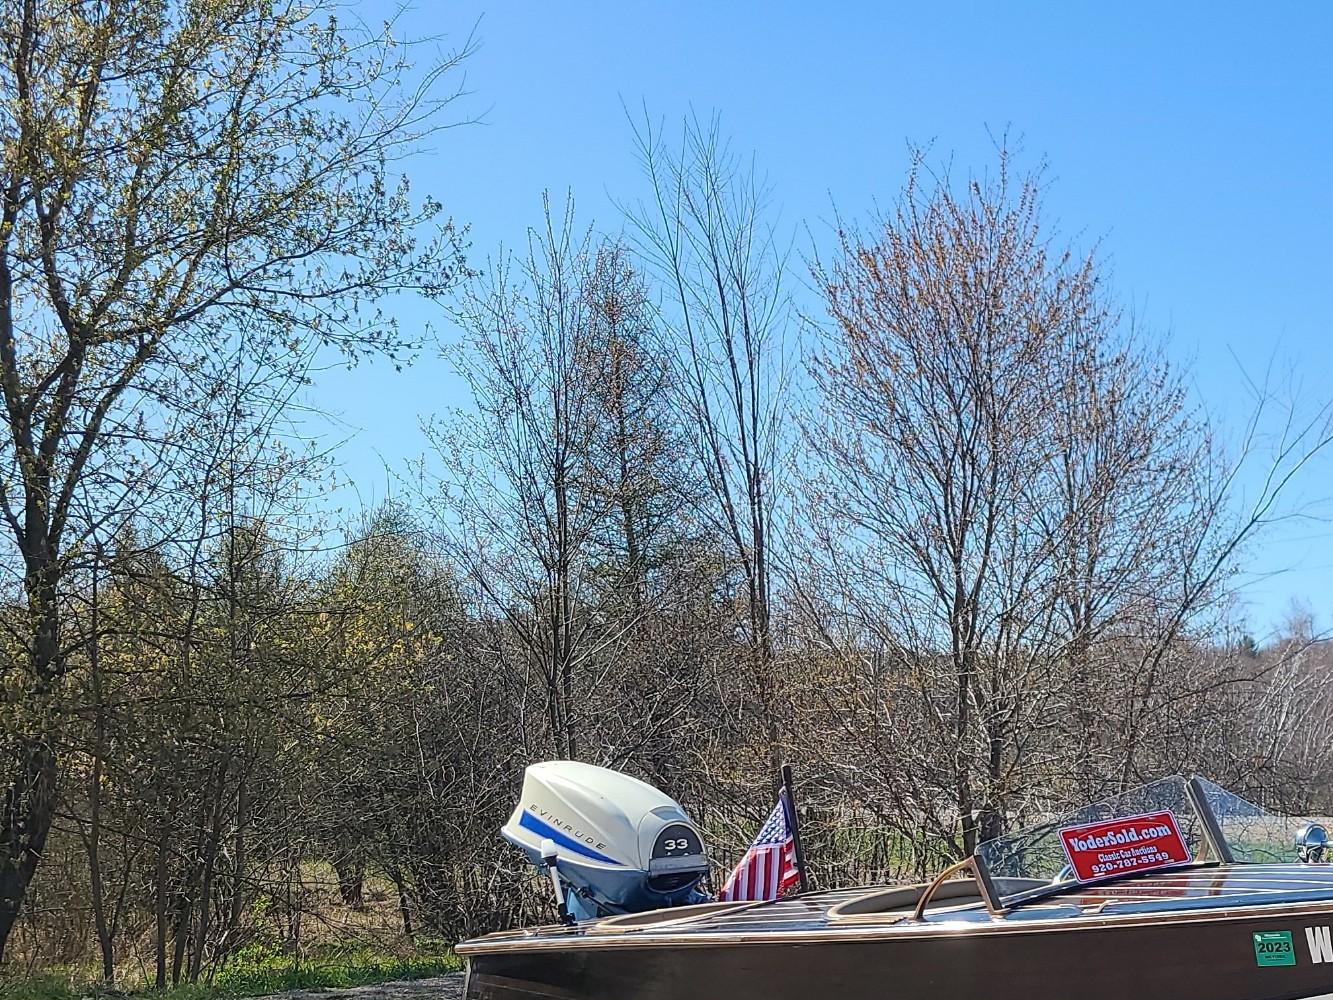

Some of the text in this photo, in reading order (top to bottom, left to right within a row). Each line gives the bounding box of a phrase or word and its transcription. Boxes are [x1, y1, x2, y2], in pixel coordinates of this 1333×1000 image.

[530, 803, 606, 850] EVINRUDE
[664, 838, 689, 850] 33
[1069, 826, 1172, 852] YoderSold.com
[1091, 852, 1169, 873] 920-787-5549
[1098, 852, 1120, 862] Classic
[1258, 941, 1290, 953] 2023
